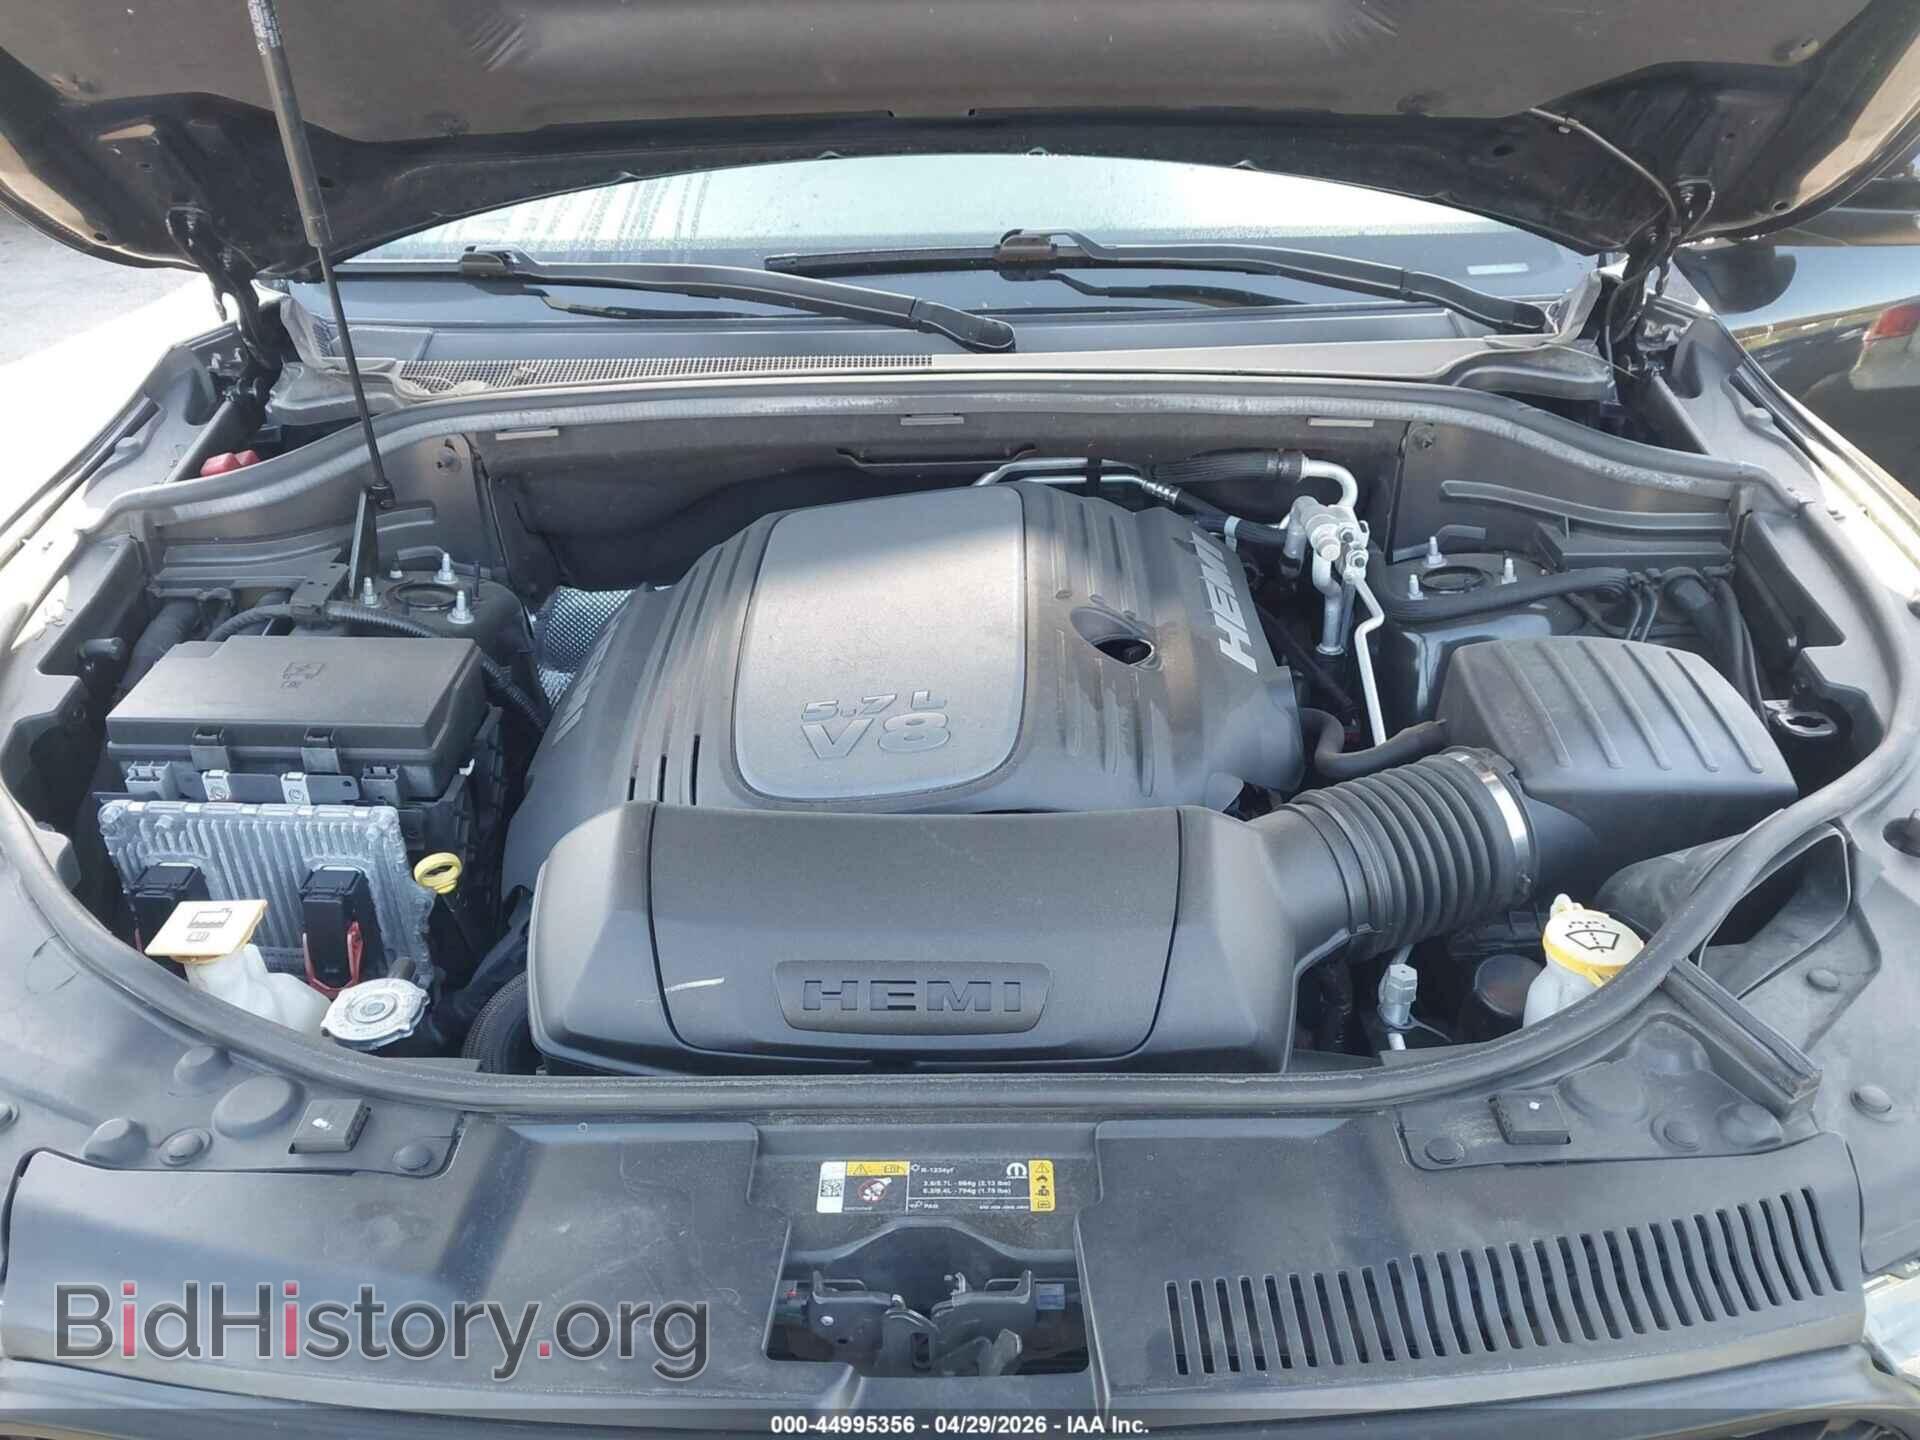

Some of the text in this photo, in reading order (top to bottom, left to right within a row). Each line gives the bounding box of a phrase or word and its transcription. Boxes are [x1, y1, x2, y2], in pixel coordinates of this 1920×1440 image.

[1189, 531, 1258, 673] HEMI
[800, 711, 951, 760] V8
[803, 980, 1021, 1011] HEMI
